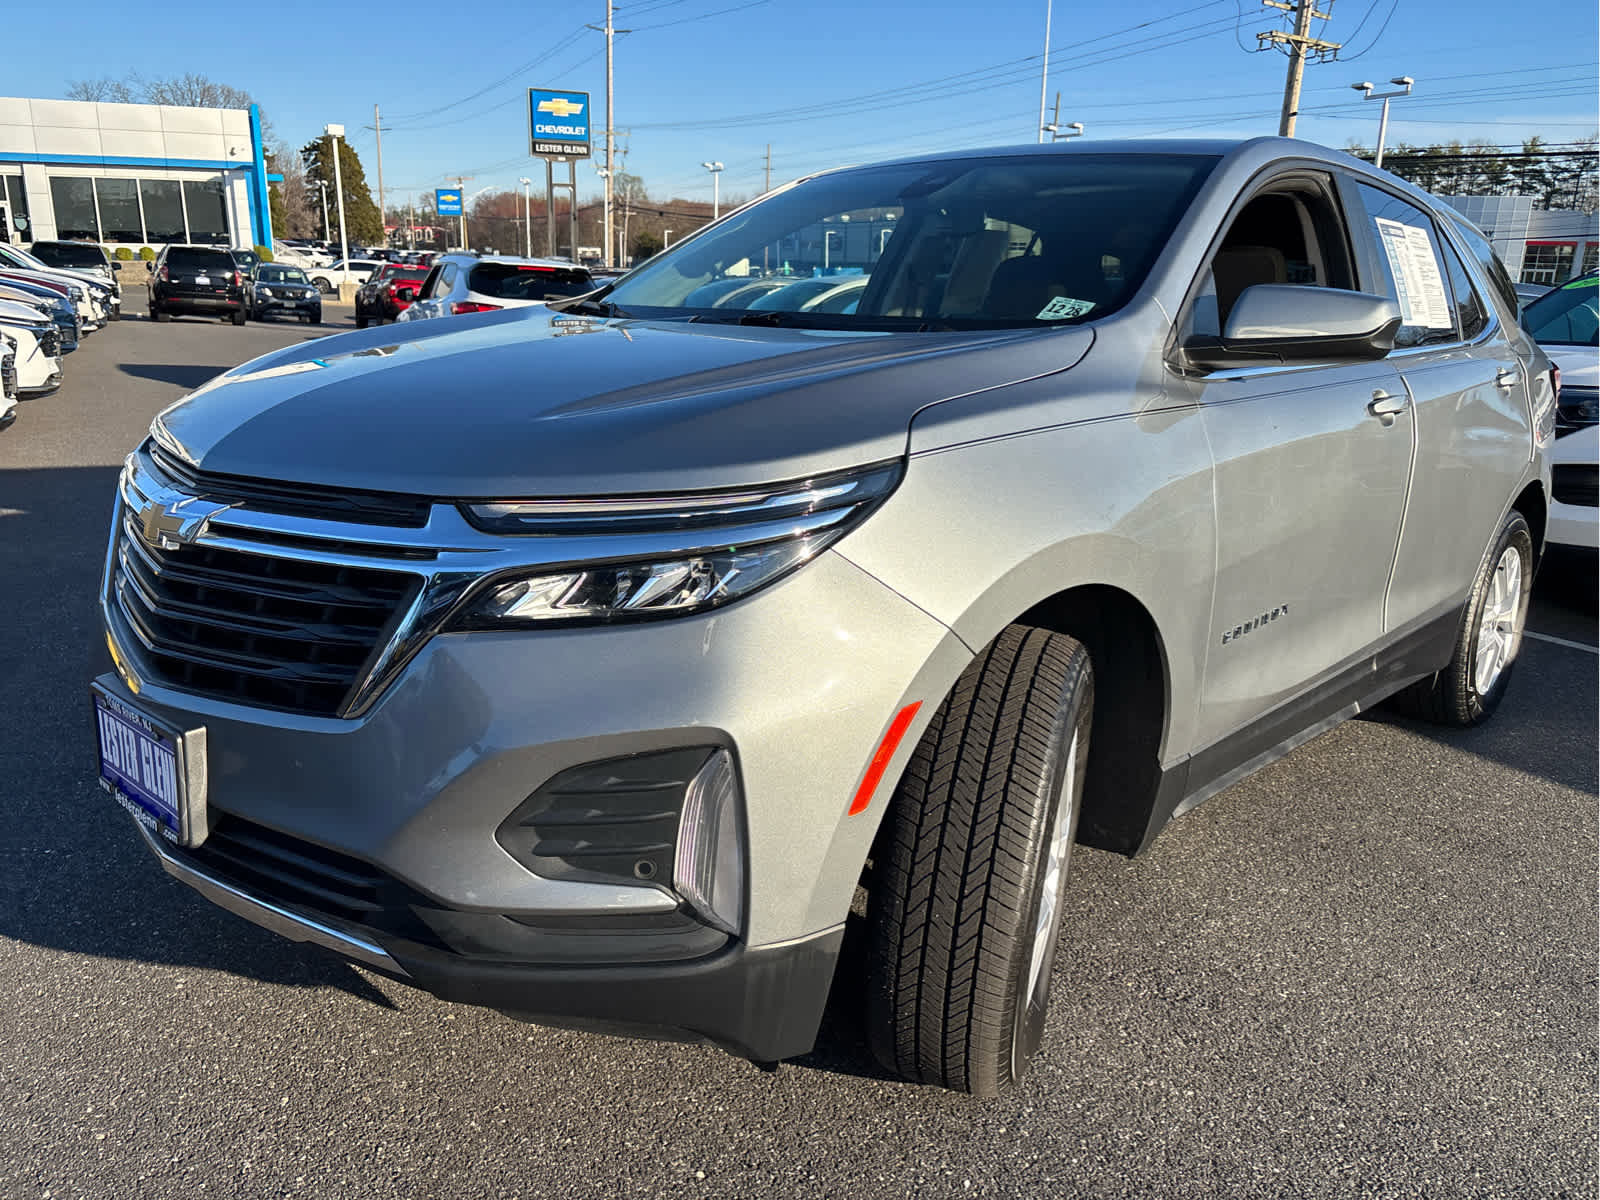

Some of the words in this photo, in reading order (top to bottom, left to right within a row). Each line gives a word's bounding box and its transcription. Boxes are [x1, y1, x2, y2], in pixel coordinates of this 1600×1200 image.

[535, 124, 586, 135] CHEVROLET
[535, 144, 562, 153] LESTER
[563, 145, 587, 154] GLENN
[1046, 303, 1065, 313] 12
[1064, 306, 1082, 316] 28
[1222, 602, 1289, 645] EQUINOX
[97, 708, 139, 784] LESTER
[140, 737, 178, 811] GLENN
